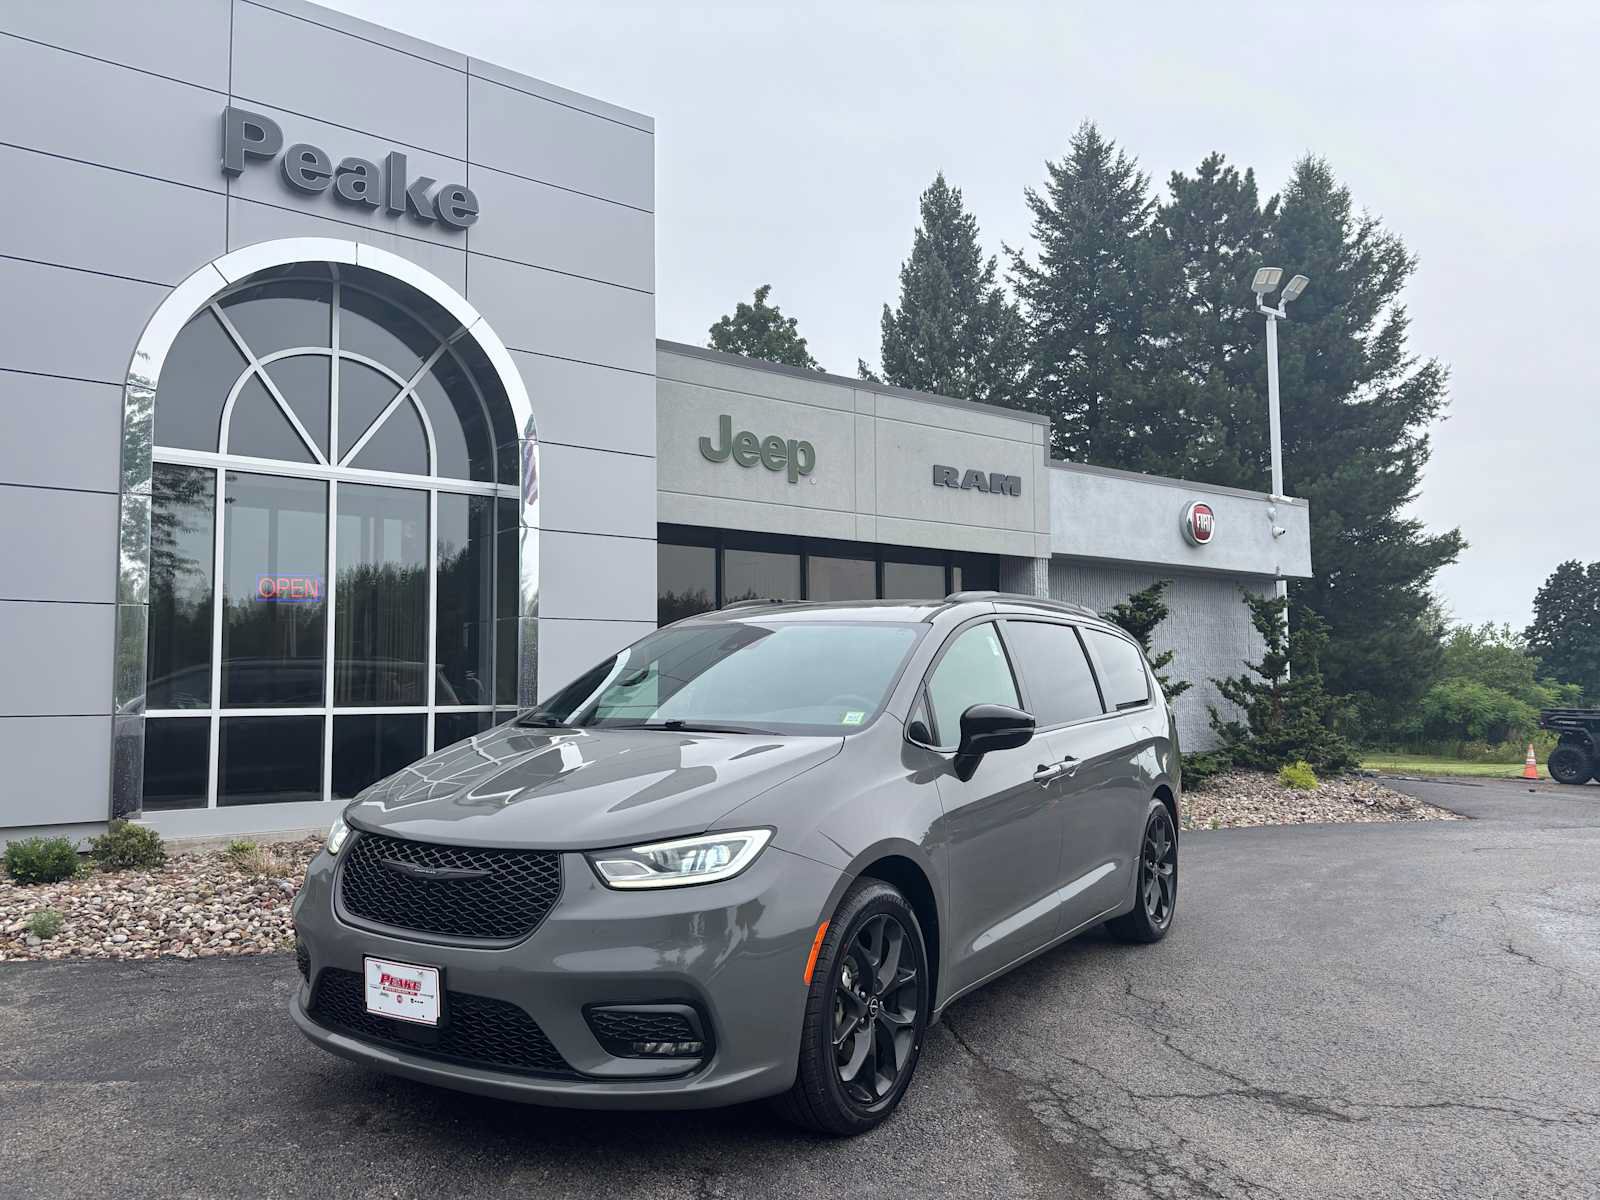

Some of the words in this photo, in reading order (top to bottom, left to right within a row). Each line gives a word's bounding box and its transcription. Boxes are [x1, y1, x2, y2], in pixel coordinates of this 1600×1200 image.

[221, 105, 480, 231] Peake
[699, 414, 816, 484] Jeep
[932, 464, 1022, 497] RAM
[1195, 512, 1212, 531] FIAT
[259, 576, 318, 598] OPEN
